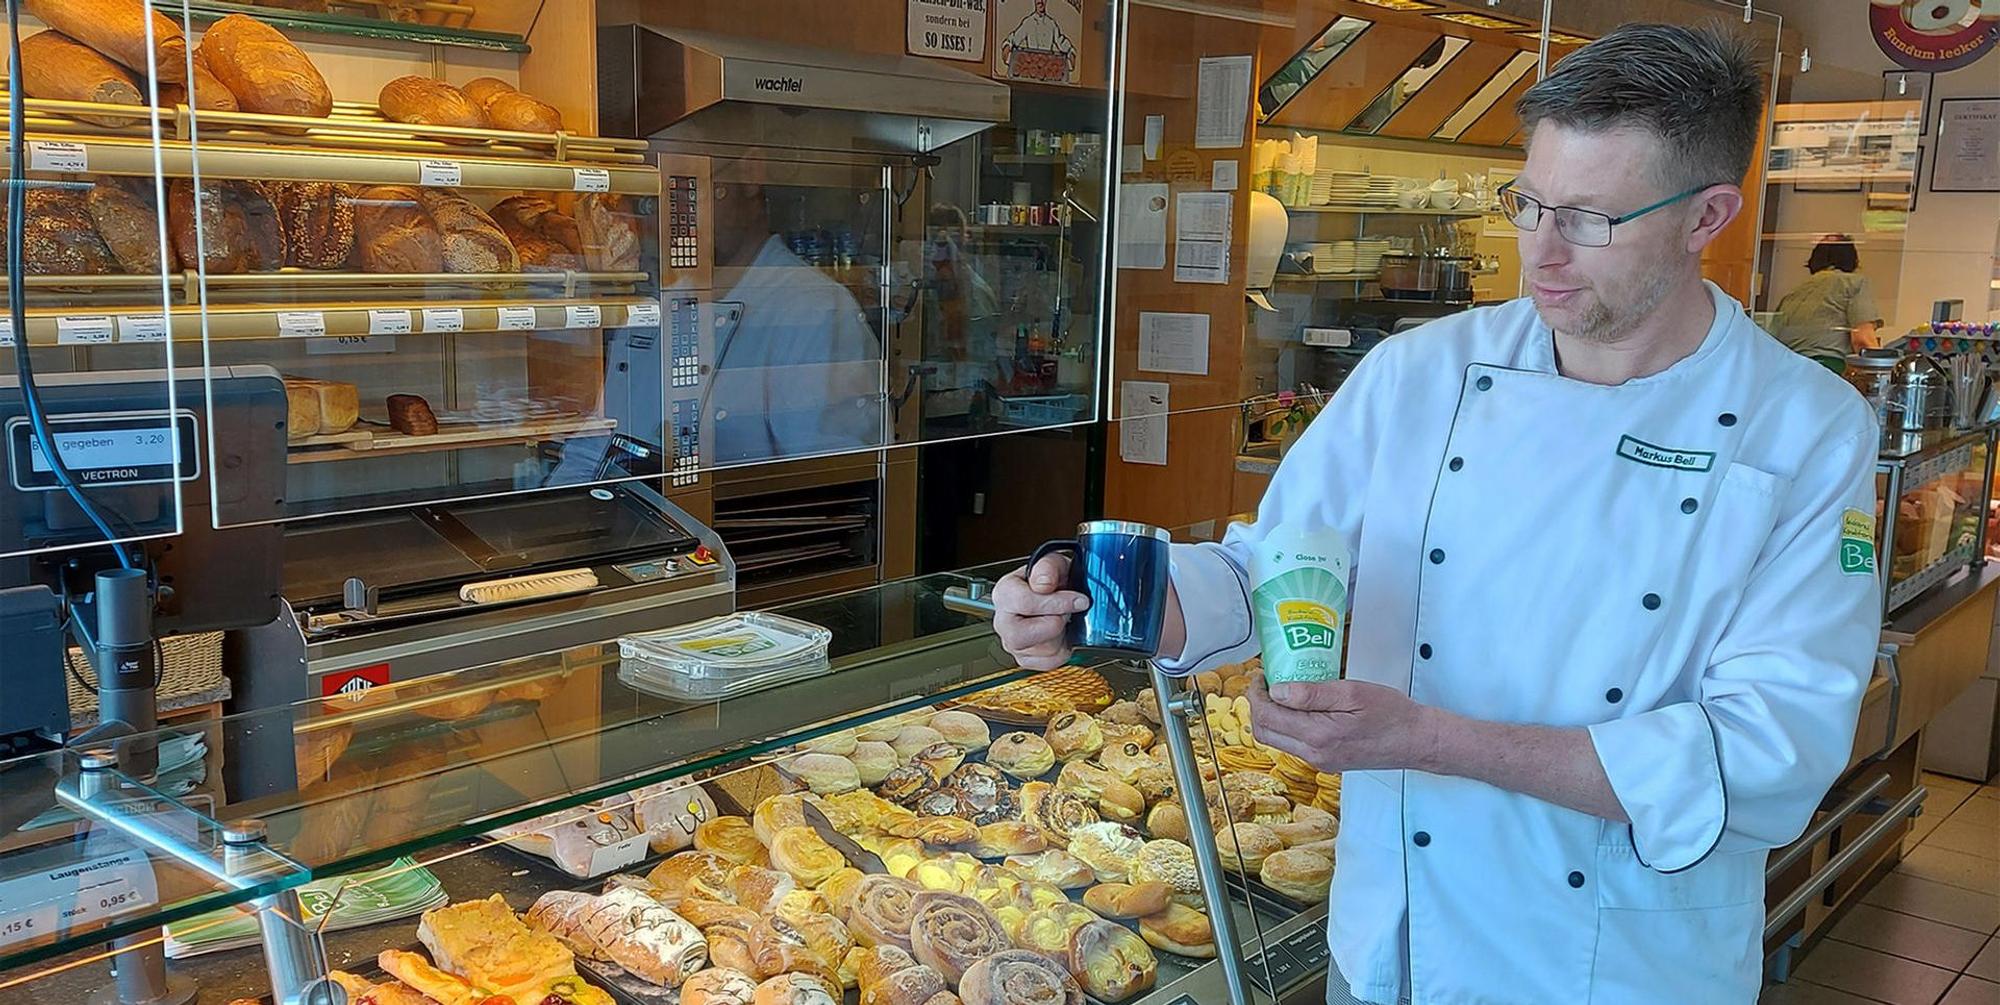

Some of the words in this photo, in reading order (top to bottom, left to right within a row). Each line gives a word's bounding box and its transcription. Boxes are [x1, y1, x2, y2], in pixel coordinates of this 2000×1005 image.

[925, 14, 957, 27] sondern
[958, 17, 970, 28] bei
[925, 31, 938, 49] SO
[941, 32, 966, 51] ISSES
[1883, 27, 1935, 59] Rundum
[1939, 35, 1984, 59] lecker
[755, 77, 803, 92] wachtel
[62, 438, 114, 449] gegeben
[1634, 446, 1672, 463] Markus
[1674, 455, 1696, 465] Bell
[81, 469, 138, 481] VECTRON
[1288, 626, 1332, 647] Bell
[50, 856, 130, 881] Laugenstange
[100, 894, 126, 909] 0,95
[25, 918, 33, 928] €
